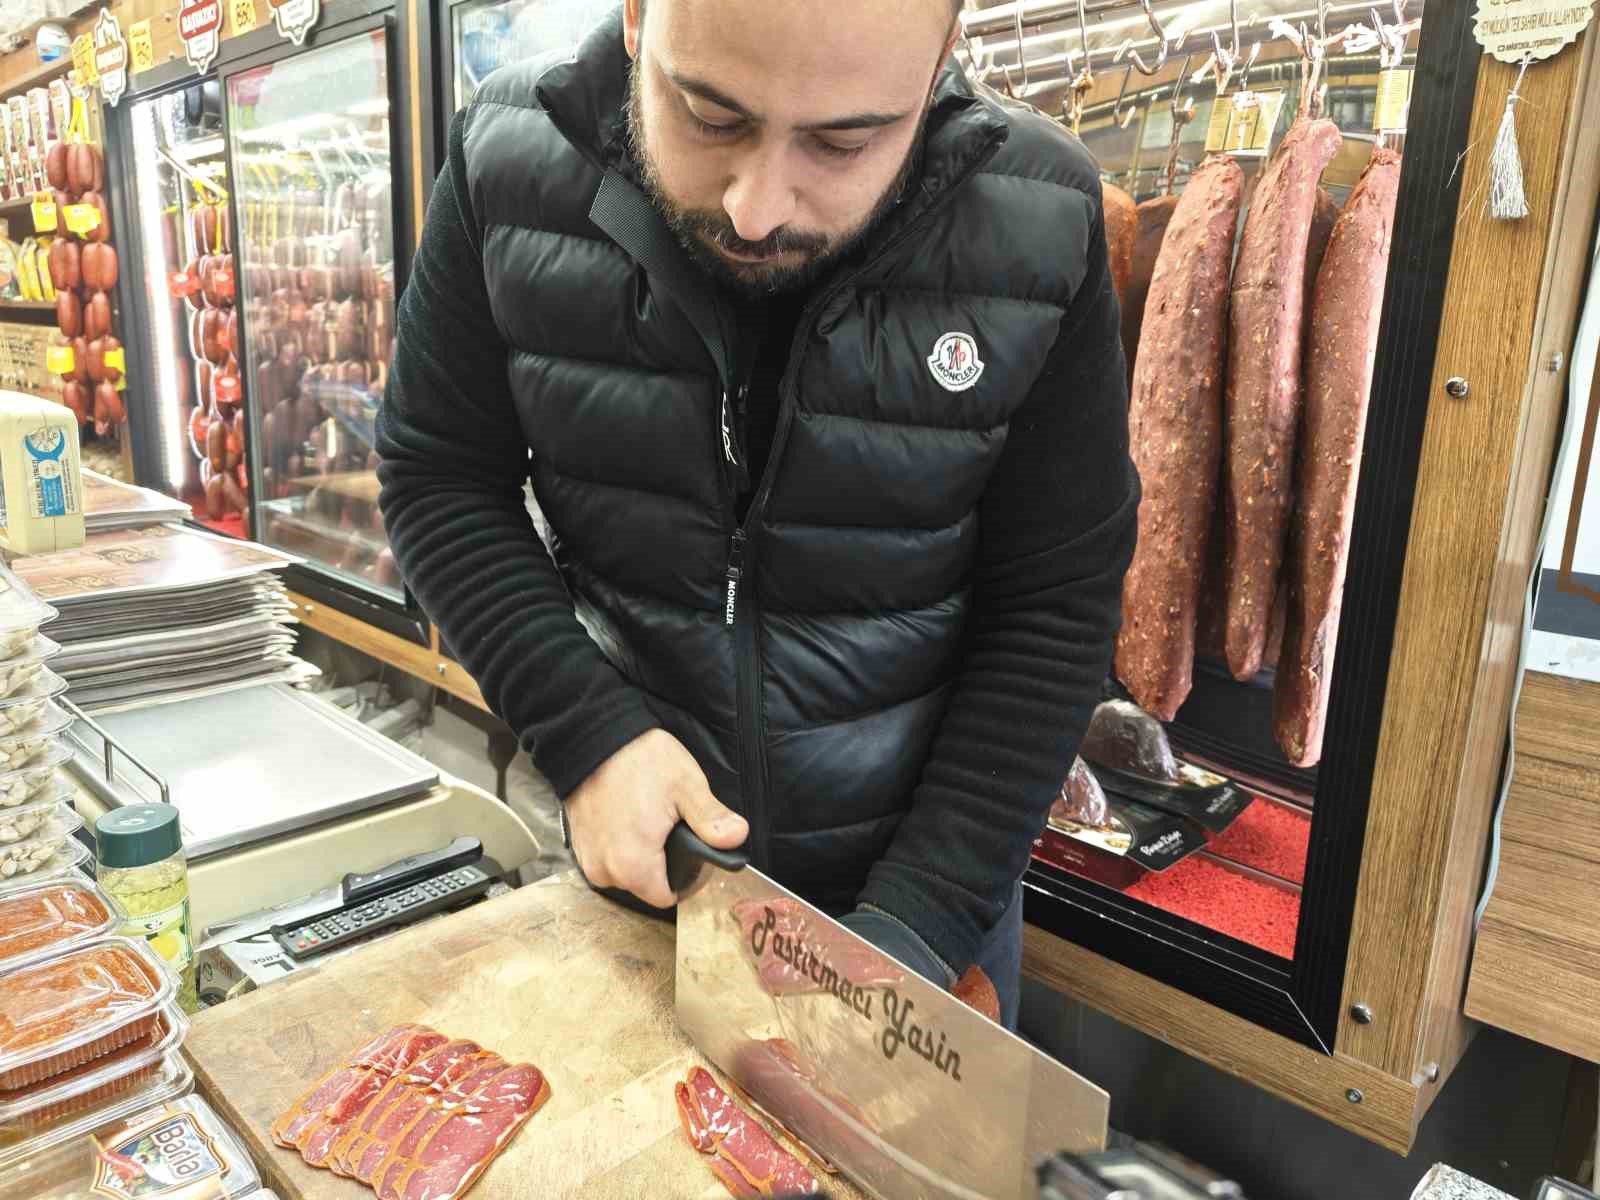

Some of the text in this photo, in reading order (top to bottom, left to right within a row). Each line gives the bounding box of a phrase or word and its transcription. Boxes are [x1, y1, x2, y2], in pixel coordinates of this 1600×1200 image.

[936, 362, 975, 381] MONCLER
[726, 580, 737, 625] MONCLER
[751, 906, 962, 1080] Pastırmacı Yasin
[154, 1124, 200, 1177] Barla
